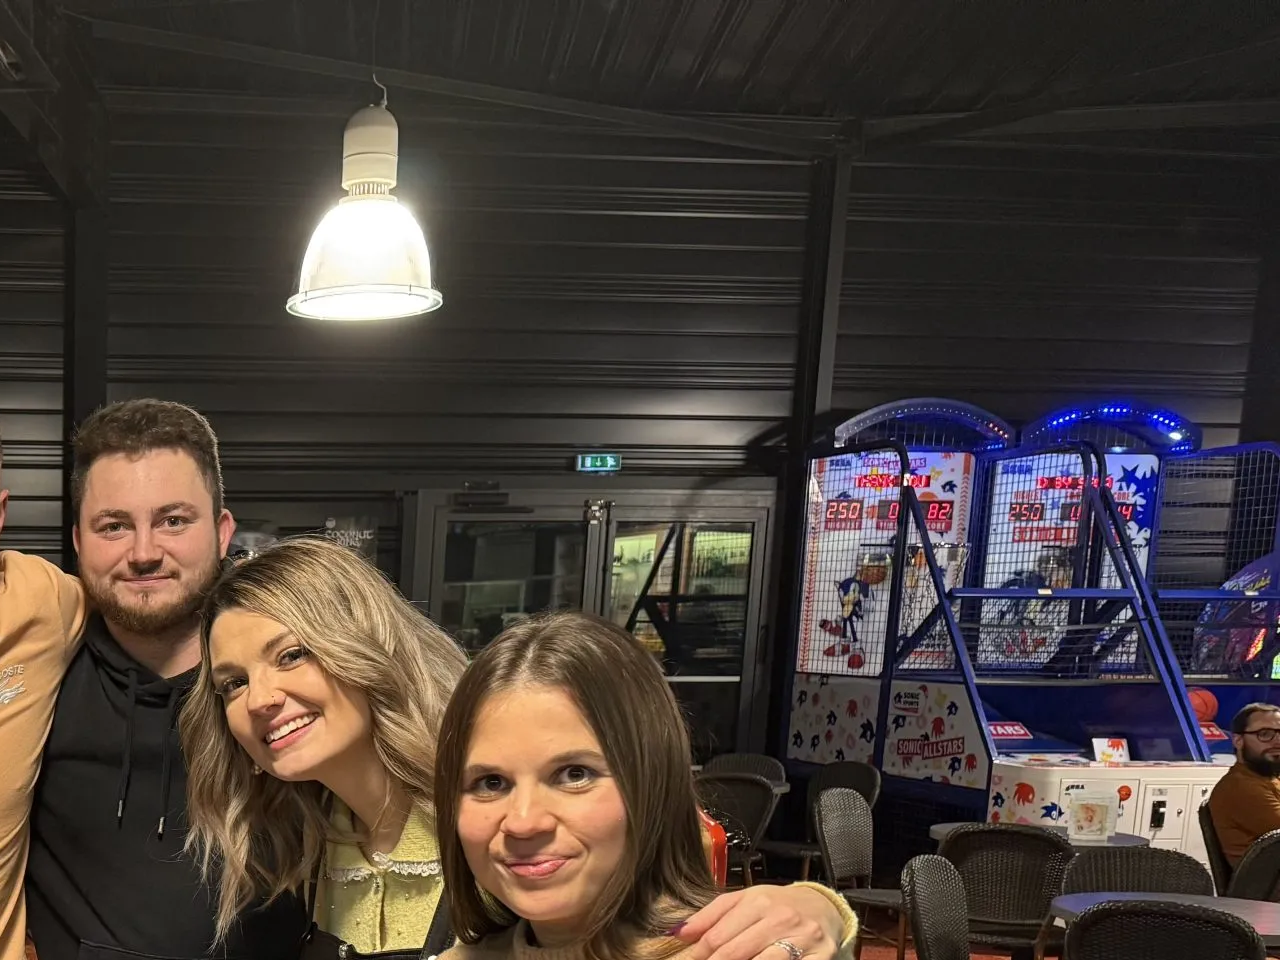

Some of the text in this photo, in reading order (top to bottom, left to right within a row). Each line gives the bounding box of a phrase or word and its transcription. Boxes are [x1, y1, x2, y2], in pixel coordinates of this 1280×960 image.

[826, 503, 860, 518] 250
[927, 504, 950, 518] 82
[1009, 504, 1042, 521] 250
[904, 692, 920, 700] SONIC
[898, 740, 922, 754] SONIC
[923, 739, 964, 758] ALLSTARS
